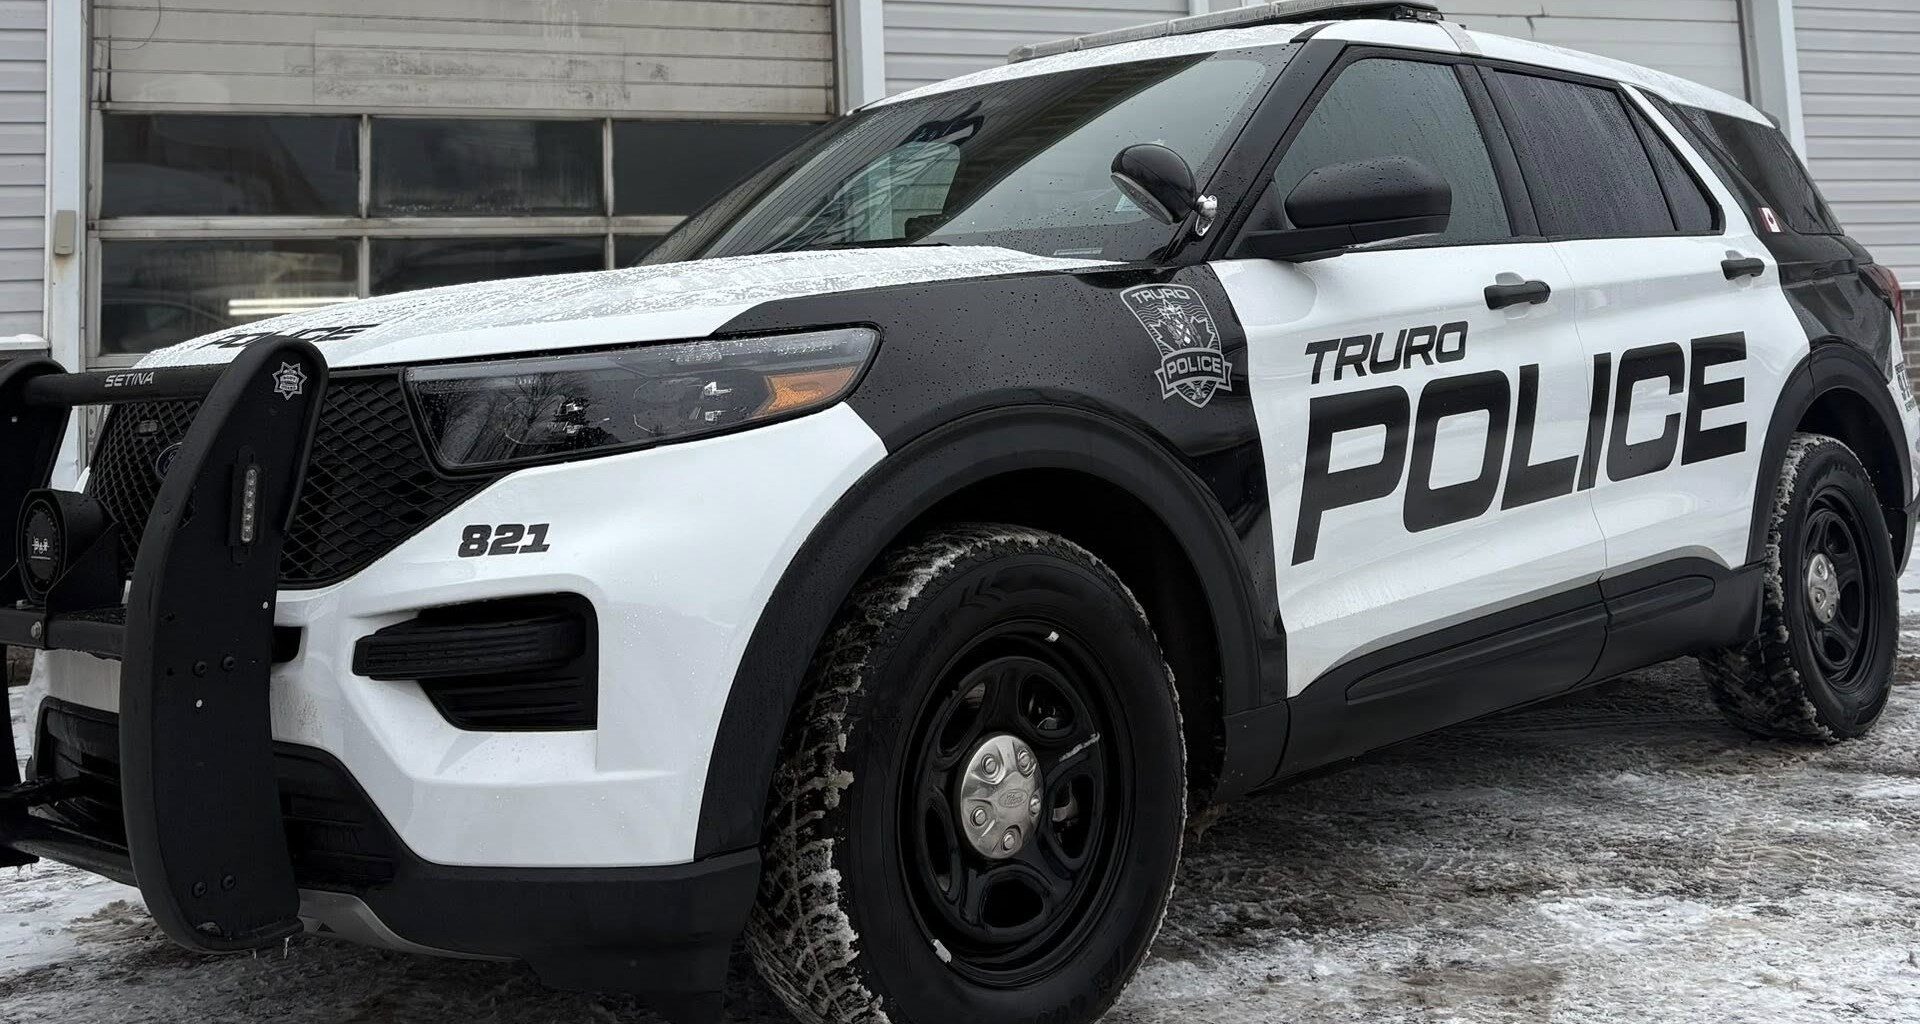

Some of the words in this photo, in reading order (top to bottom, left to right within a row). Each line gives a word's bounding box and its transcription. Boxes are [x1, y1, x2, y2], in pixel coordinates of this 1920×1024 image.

[1131, 288, 1191, 304] TRURO
[1166, 355, 1222, 379] POLICE
[1304, 320, 1469, 385] TRURO
[104, 371, 155, 388] SETINA
[1291, 331, 1747, 566] POLICE
[458, 523, 550, 558] 821
